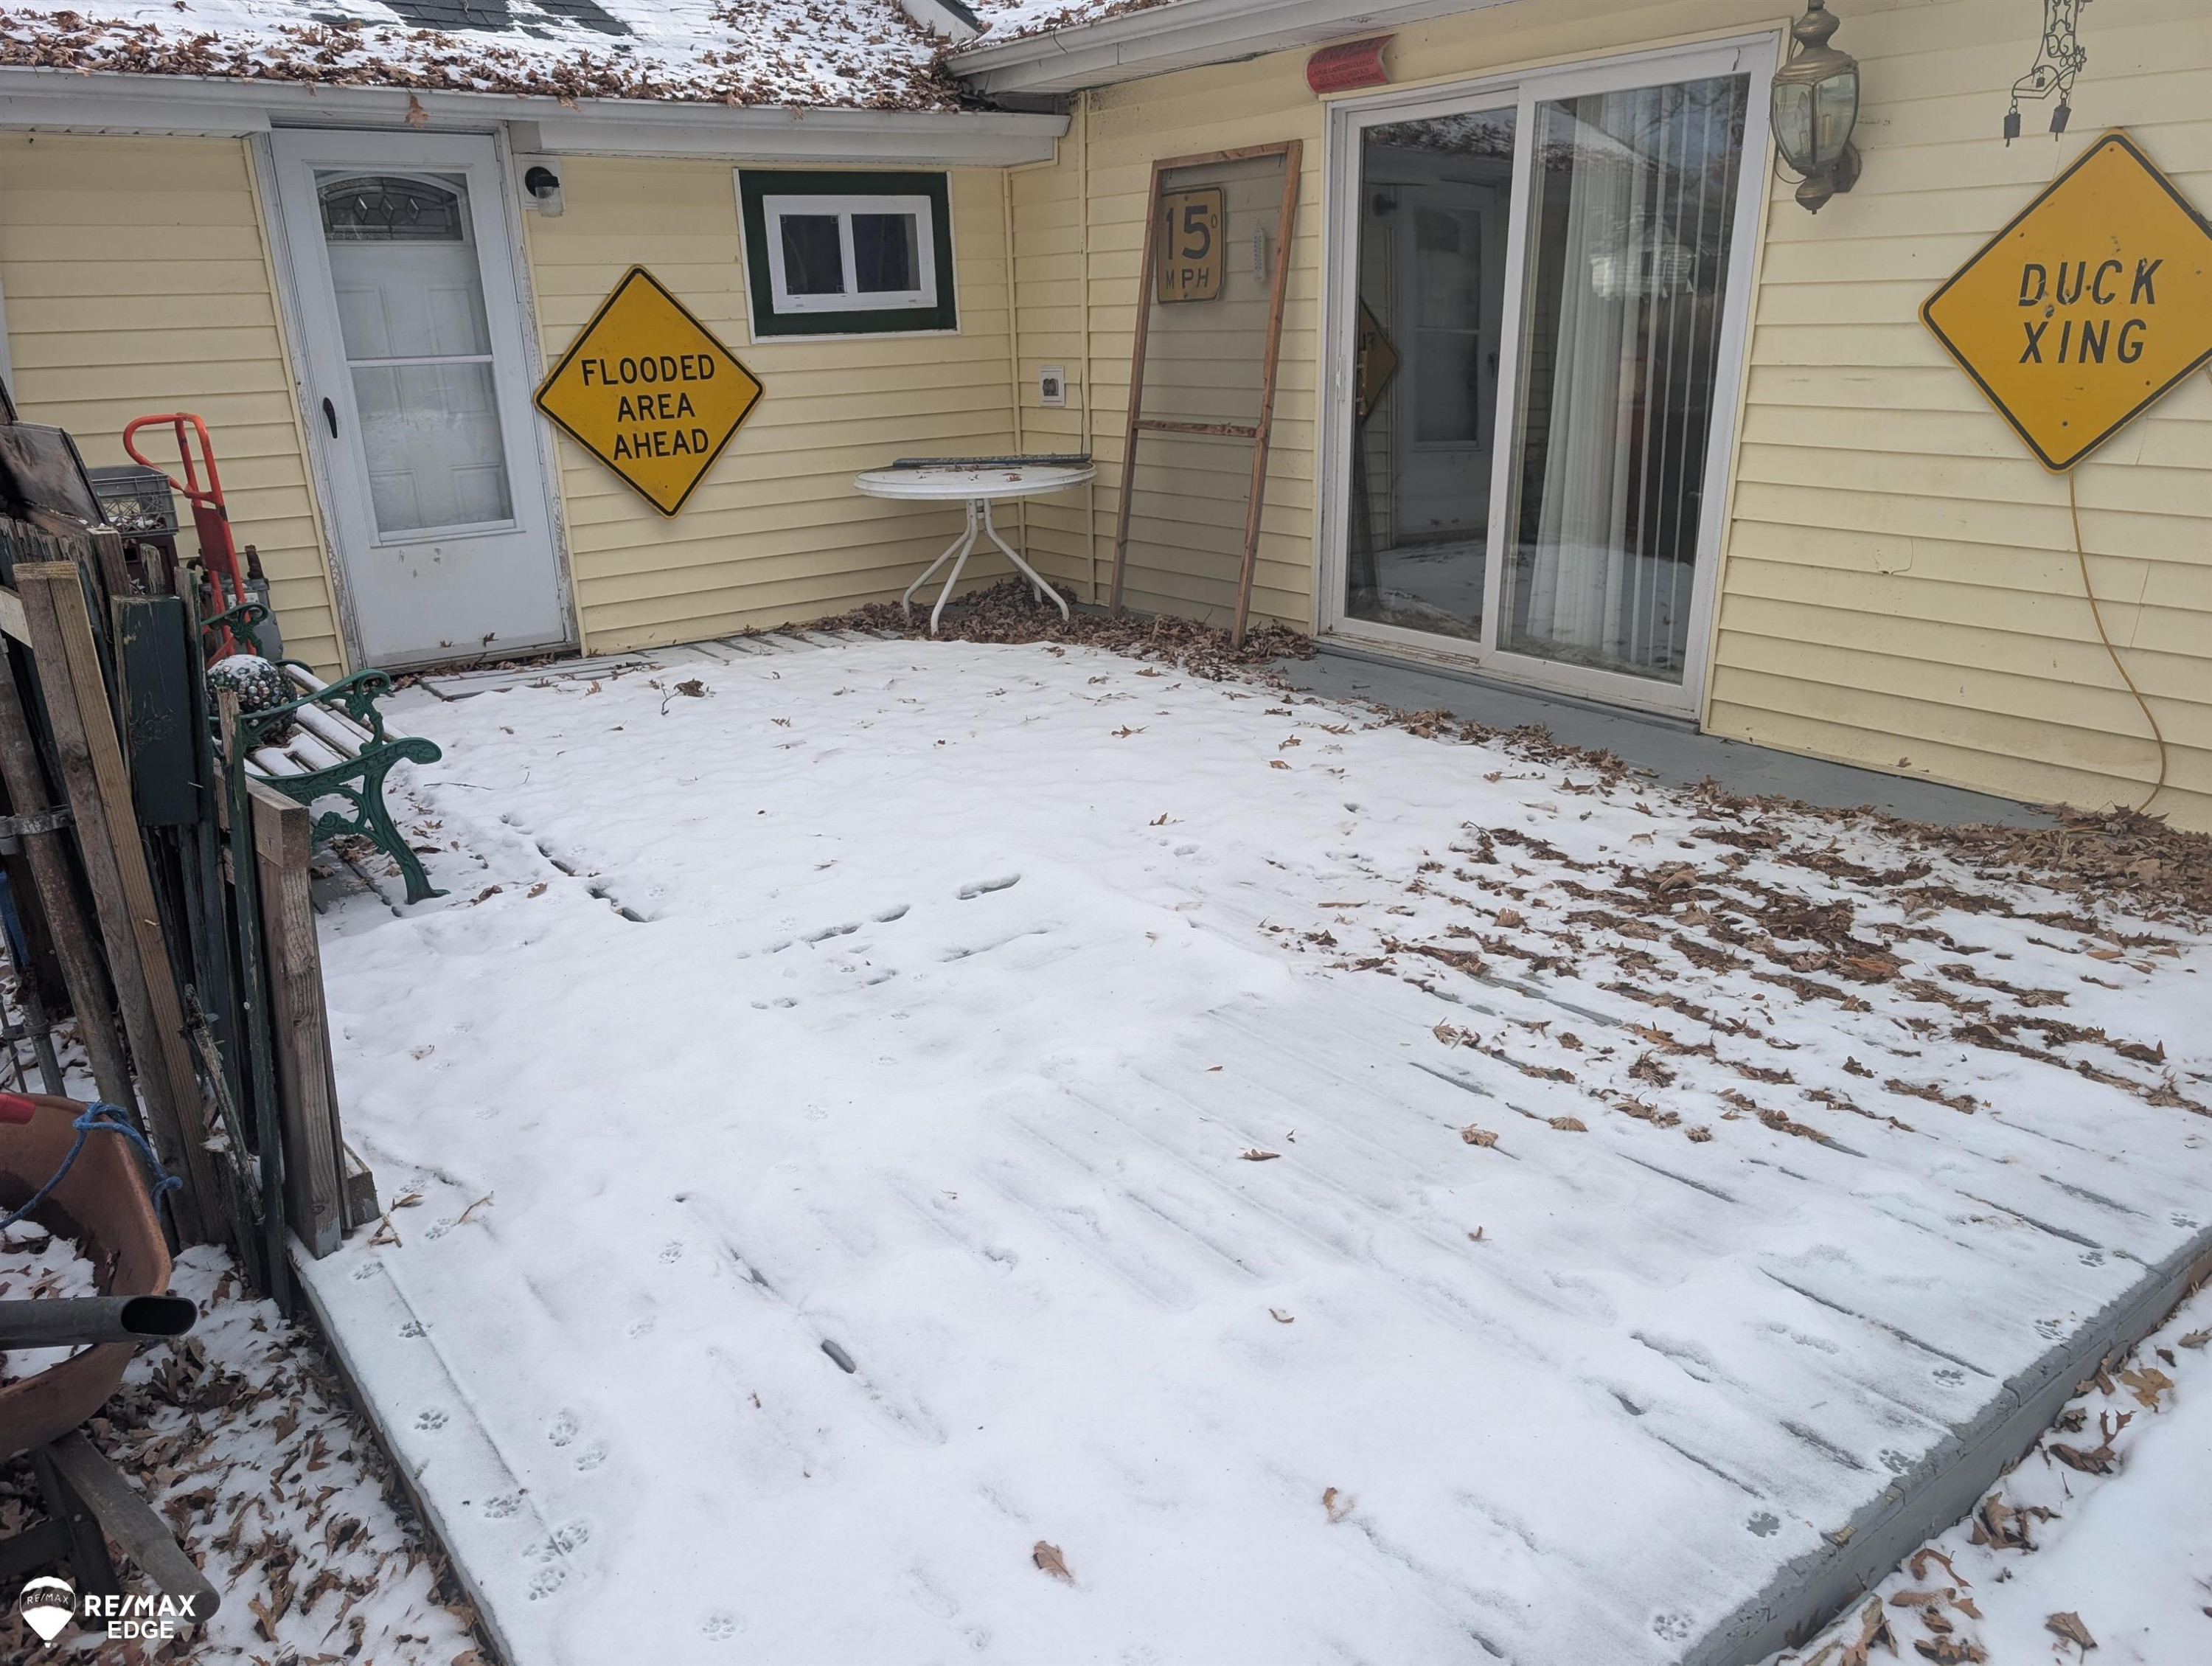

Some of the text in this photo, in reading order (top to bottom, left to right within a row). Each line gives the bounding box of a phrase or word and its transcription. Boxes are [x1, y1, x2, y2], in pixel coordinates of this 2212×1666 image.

[1166, 205, 1211, 260] 15
[1166, 267, 1209, 289] MPH
[2018, 260, 2164, 306] DUCK
[2018, 319, 2146, 364] XING
[581, 354, 715, 386] FLOODED
[617, 392, 696, 423] AREA
[613, 428, 709, 460] AHEAD
